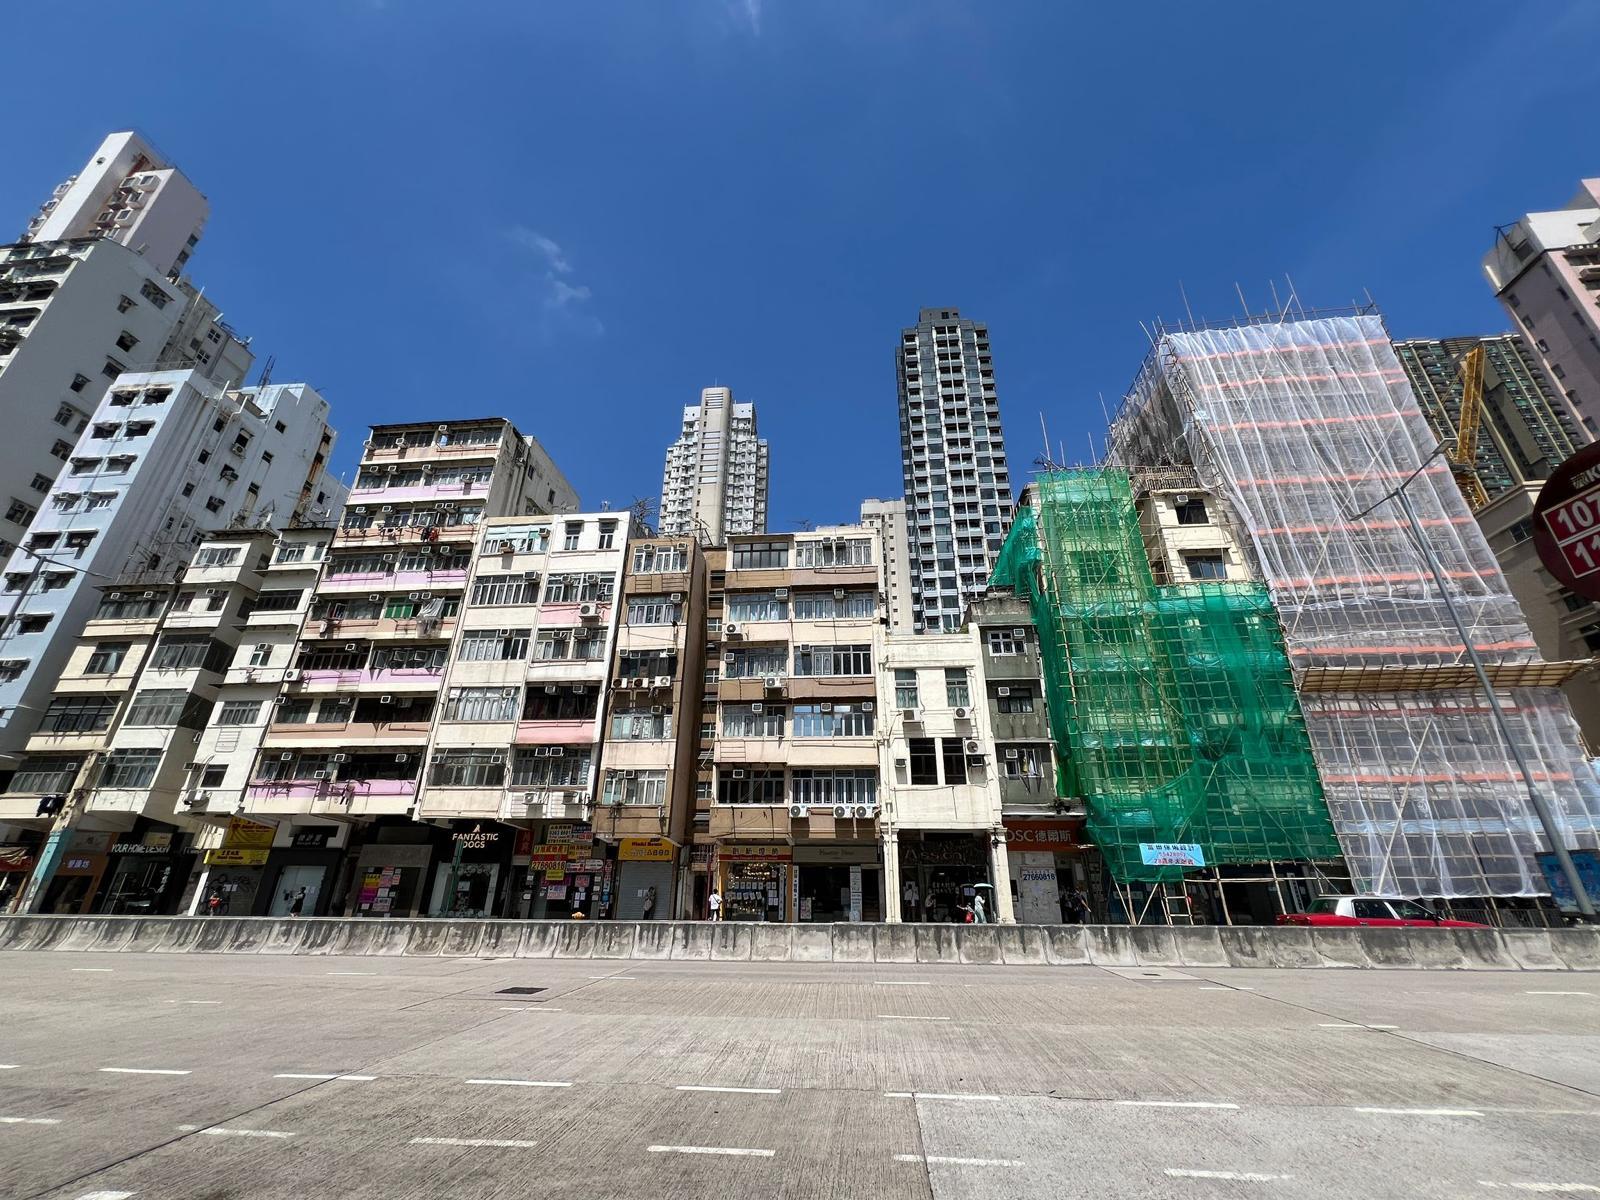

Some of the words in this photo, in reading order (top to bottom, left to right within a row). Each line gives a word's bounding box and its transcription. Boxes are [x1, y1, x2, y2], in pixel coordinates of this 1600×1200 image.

[1557, 492, 1600, 534] 107
[452, 833, 499, 841] FANTASTIC
[111, 843, 129, 853] YOUR
[128, 844, 146, 854] HOME
[462, 840, 486, 849] DOGS
